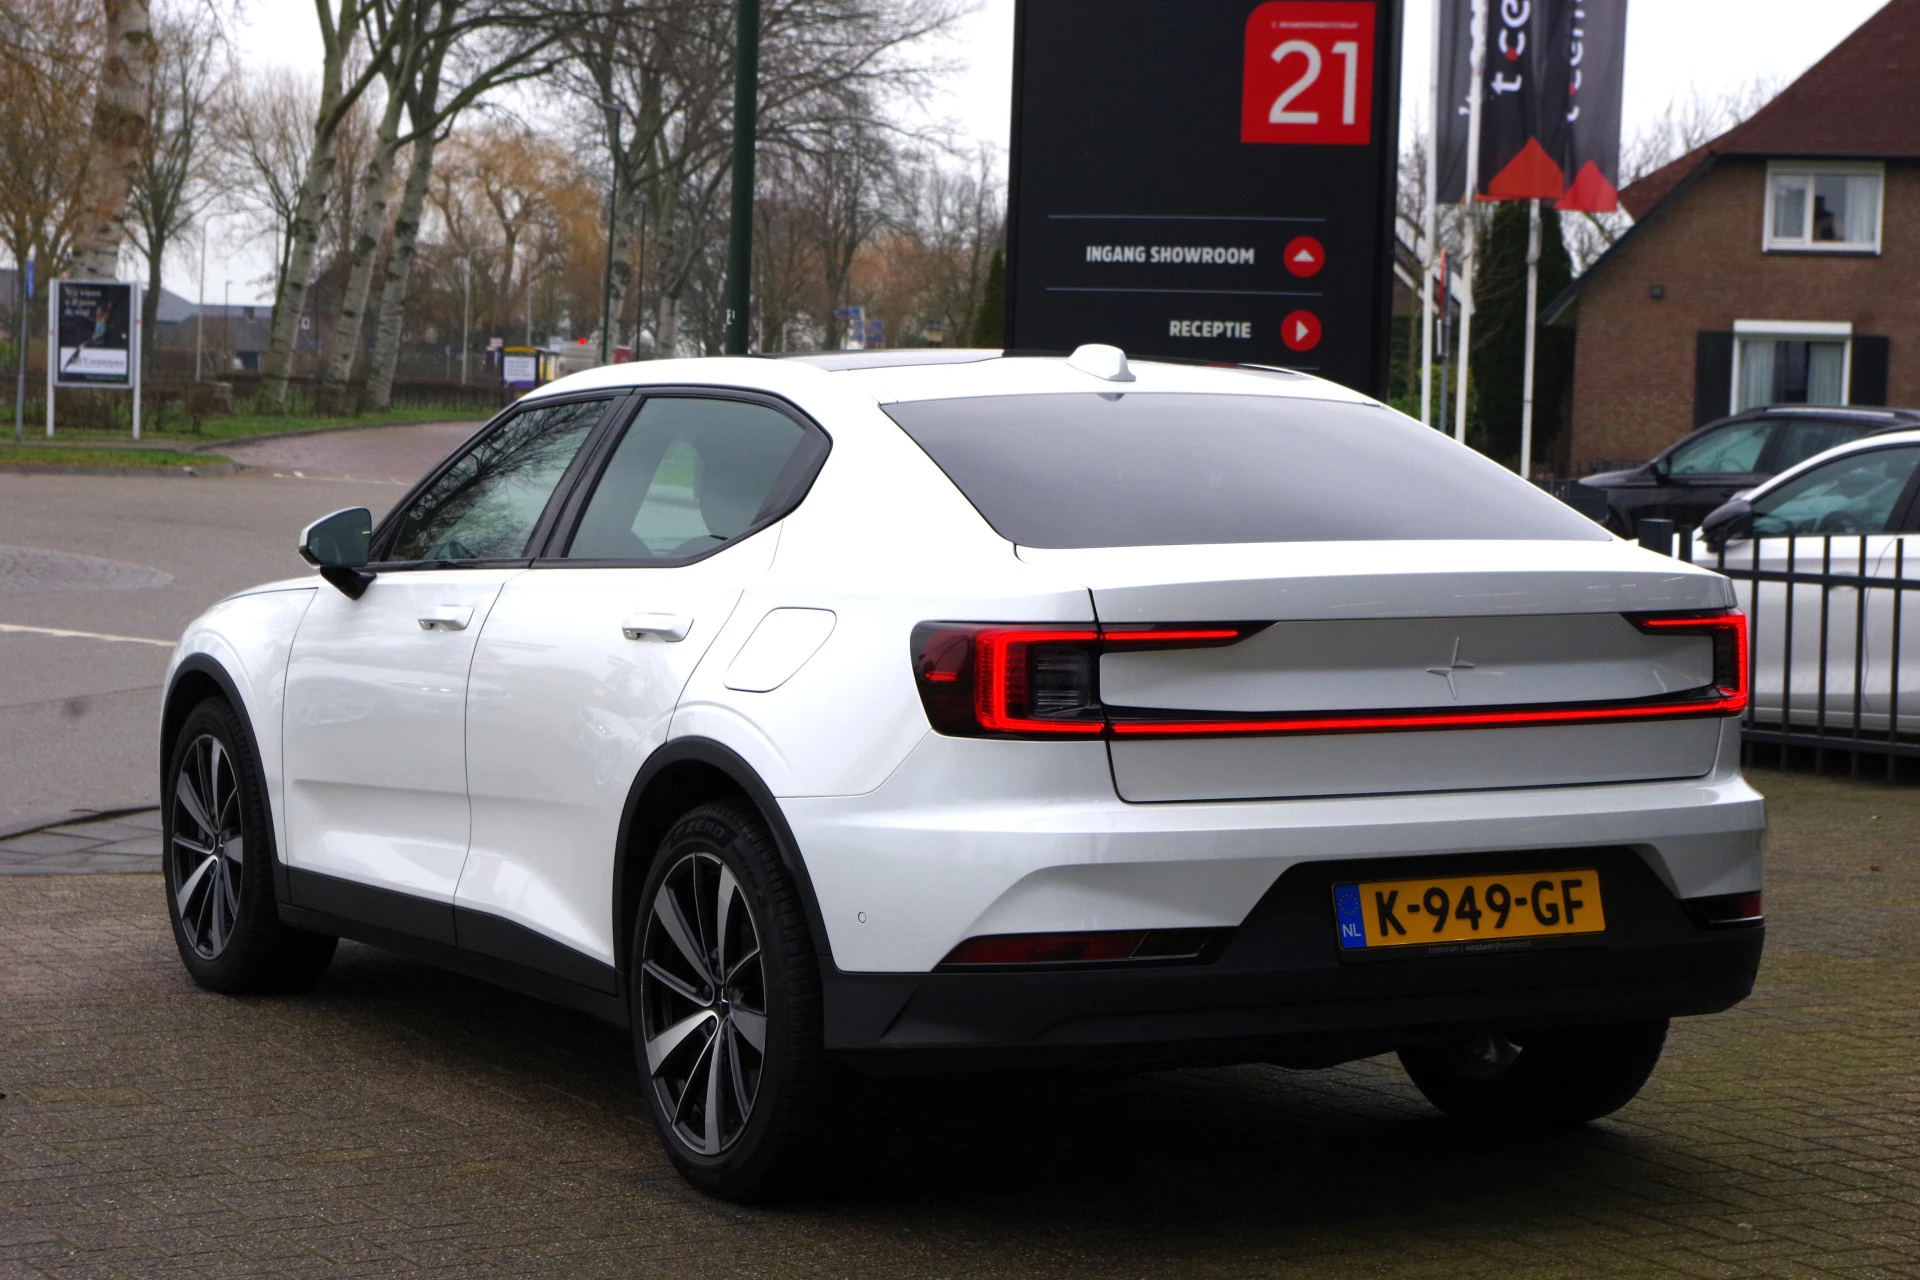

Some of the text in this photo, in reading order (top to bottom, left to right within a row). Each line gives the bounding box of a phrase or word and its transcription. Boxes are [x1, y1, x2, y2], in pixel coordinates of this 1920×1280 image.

[1269, 39, 1358, 125] 21
[1086, 245, 1254, 264] INGANG SHOWROOM
[1169, 320, 1252, 339] RECEPTIE
[1375, 879, 1584, 937] K-949-GF
[1343, 924, 1361, 938] NL
